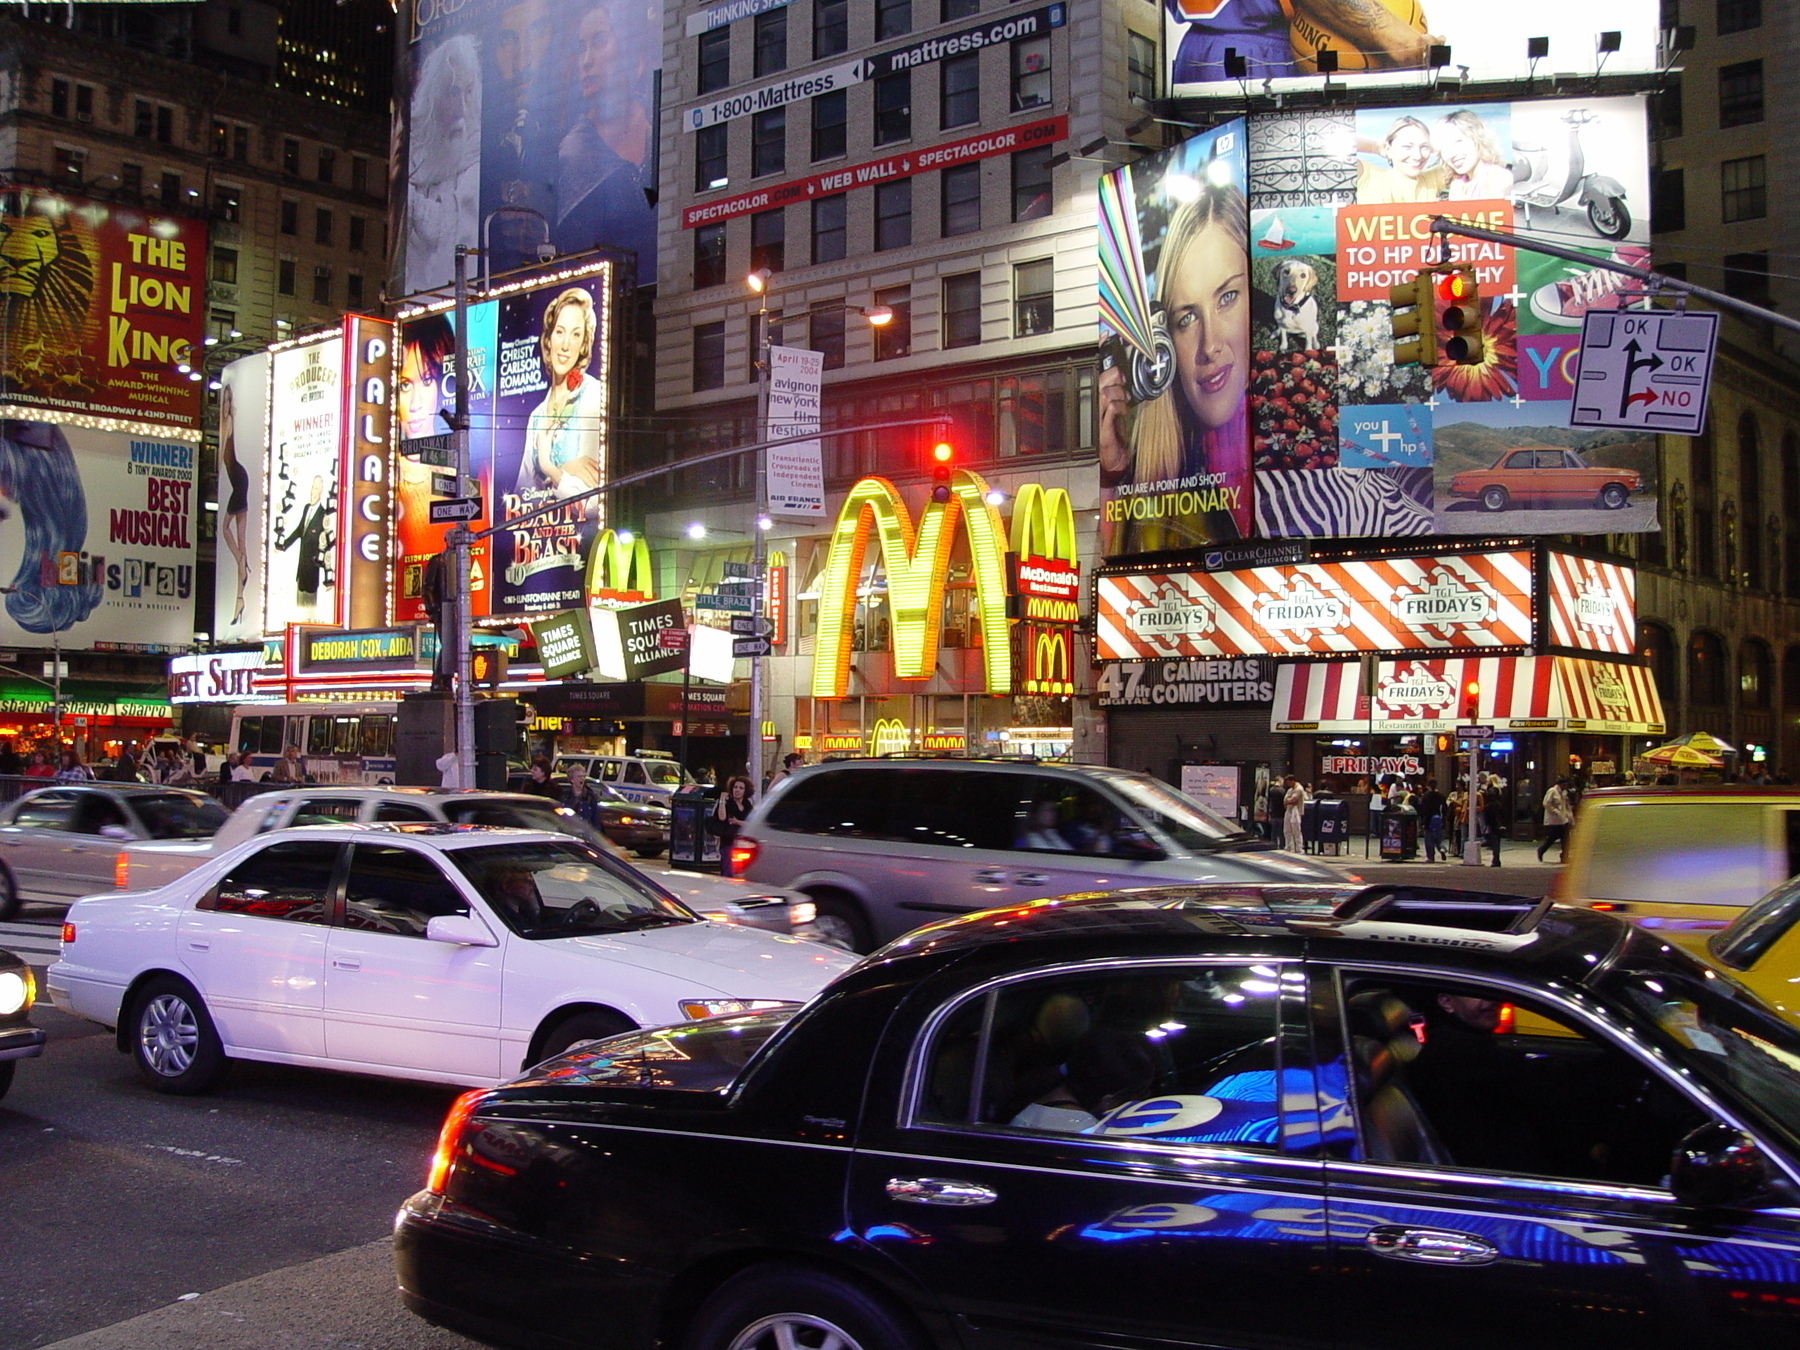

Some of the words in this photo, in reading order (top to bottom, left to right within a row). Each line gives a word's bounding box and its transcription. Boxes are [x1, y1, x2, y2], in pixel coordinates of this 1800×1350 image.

[708, 0, 759, 27] THINKING
[891, 16, 1037, 71] mattress.com
[820, 172, 853, 192] WEB
[857, 162, 897, 183] WALL
[918, 133, 1016, 167] SPECTACOLOR
[688, 192, 769, 223] SPECTACOLOR
[1345, 211, 1505, 242] WELCME
[128, 232, 187, 272] THE
[1346, 247, 1376, 266] TO
[1384, 246, 1414, 264] HP
[1347, 266, 1505, 289] PHOTOHY
[112, 261, 191, 315] LION
[1624, 319, 1648, 335] OK
[108, 316, 192, 369] KING
[309, 351, 321, 365] THE
[500, 345, 535, 363] CHRISTY
[777, 353, 799, 365] April
[801, 356, 820, 367] 19-25
[1670, 355, 1696, 372] OK
[500, 356, 541, 376] CARLSON
[799, 365, 819, 376] 2004
[141, 371, 160, 381] THE
[500, 369, 542, 390] ROMANO
[774, 377, 819, 394] avignon
[107, 378, 191, 398] AWARD-WINNING
[128, 393, 170, 405] MUSICAL
[1661, 390, 1692, 407] NO
[0, 393, 48, 405] MSTERDAM
[89, 402, 137, 416] BROADWAY
[144, 408, 166, 419] 42ND
[166, 411, 194, 424] STREET
[793, 410, 819, 424] film
[1354, 419, 1379, 434] you
[358, 338, 387, 561] PALACE
[402, 435, 445, 454] BROADWAY
[1400, 438, 1417, 456] hp
[130, 440, 194, 469] WINNER!
[771, 454, 820, 464] Transatlantic
[127, 462, 133, 474] 8
[135, 465, 151, 476] TONY
[151, 466, 177, 479] AWARDS
[771, 462, 811, 472] Crossroads
[812, 465, 820, 473] of
[773, 471, 821, 481] Independent
[438, 481, 454, 491] ONE
[1117, 485, 1134, 495] YOU
[1134, 482, 1149, 493] ARE
[1149, 481, 1155, 492] A
[1156, 478, 1180, 491] POINT
[1180, 476, 1198, 489] AND
[1199, 472, 1227, 486] SHOOT
[147, 477, 192, 515] BEST
[770, 494, 785, 502] AIR
[787, 495, 822, 504] FRANCE
[1105, 486, 1242, 522] REVOLUTIONARY.
[437, 507, 453, 517] ONE
[459, 504, 475, 514] WAY
[505, 494, 590, 531] BEAUTY
[110, 508, 191, 549] MUSICAL
[531, 527, 554, 538] AND
[553, 524, 576, 536] THE
[513, 530, 582, 567] BEAST
[1255, 554, 1304, 566] SPECTACOLOR
[1020, 565, 1079, 587] McDonald's
[1030, 582, 1070, 596] Restaurant
[696, 597, 722, 606] LITTLE
[723, 596, 750, 606] BRAZIL
[1267, 602, 1337, 619] FRIDAY'S
[1406, 596, 1482, 615] FRIDAY'S
[629, 614, 674, 636] TIMES
[736, 621, 750, 631] ONE
[1139, 609, 1203, 626] FRIDAY'S
[541, 623, 575, 644] TIMES
[627, 632, 660, 653] SQUA
[311, 640, 358, 661] DEBORAH
[360, 637, 381, 658] COX
[388, 636, 414, 657] AIDA
[541, 634, 582, 660] SQUARE
[633, 643, 681, 665] ALLIANCE
[737, 644, 749, 652] ONE
[753, 643, 766, 651] WAY
[548, 649, 582, 668] ALLIANCE
[1162, 660, 1260, 683] CAMERAS
[680, 691, 701, 702] TMES
[1152, 682, 1275, 704] COMPUTERS
[1389, 685, 1445, 698] FRIDAY'S
[0, 699, 50, 714] sbarro
[63, 701, 109, 715] sbarro
[121, 702, 166, 718] sbarro
[1378, 720, 1421, 730] Restaurant
[1432, 720, 1447, 729] Bar
[1331, 754, 1420, 775] FRIDAY'S
